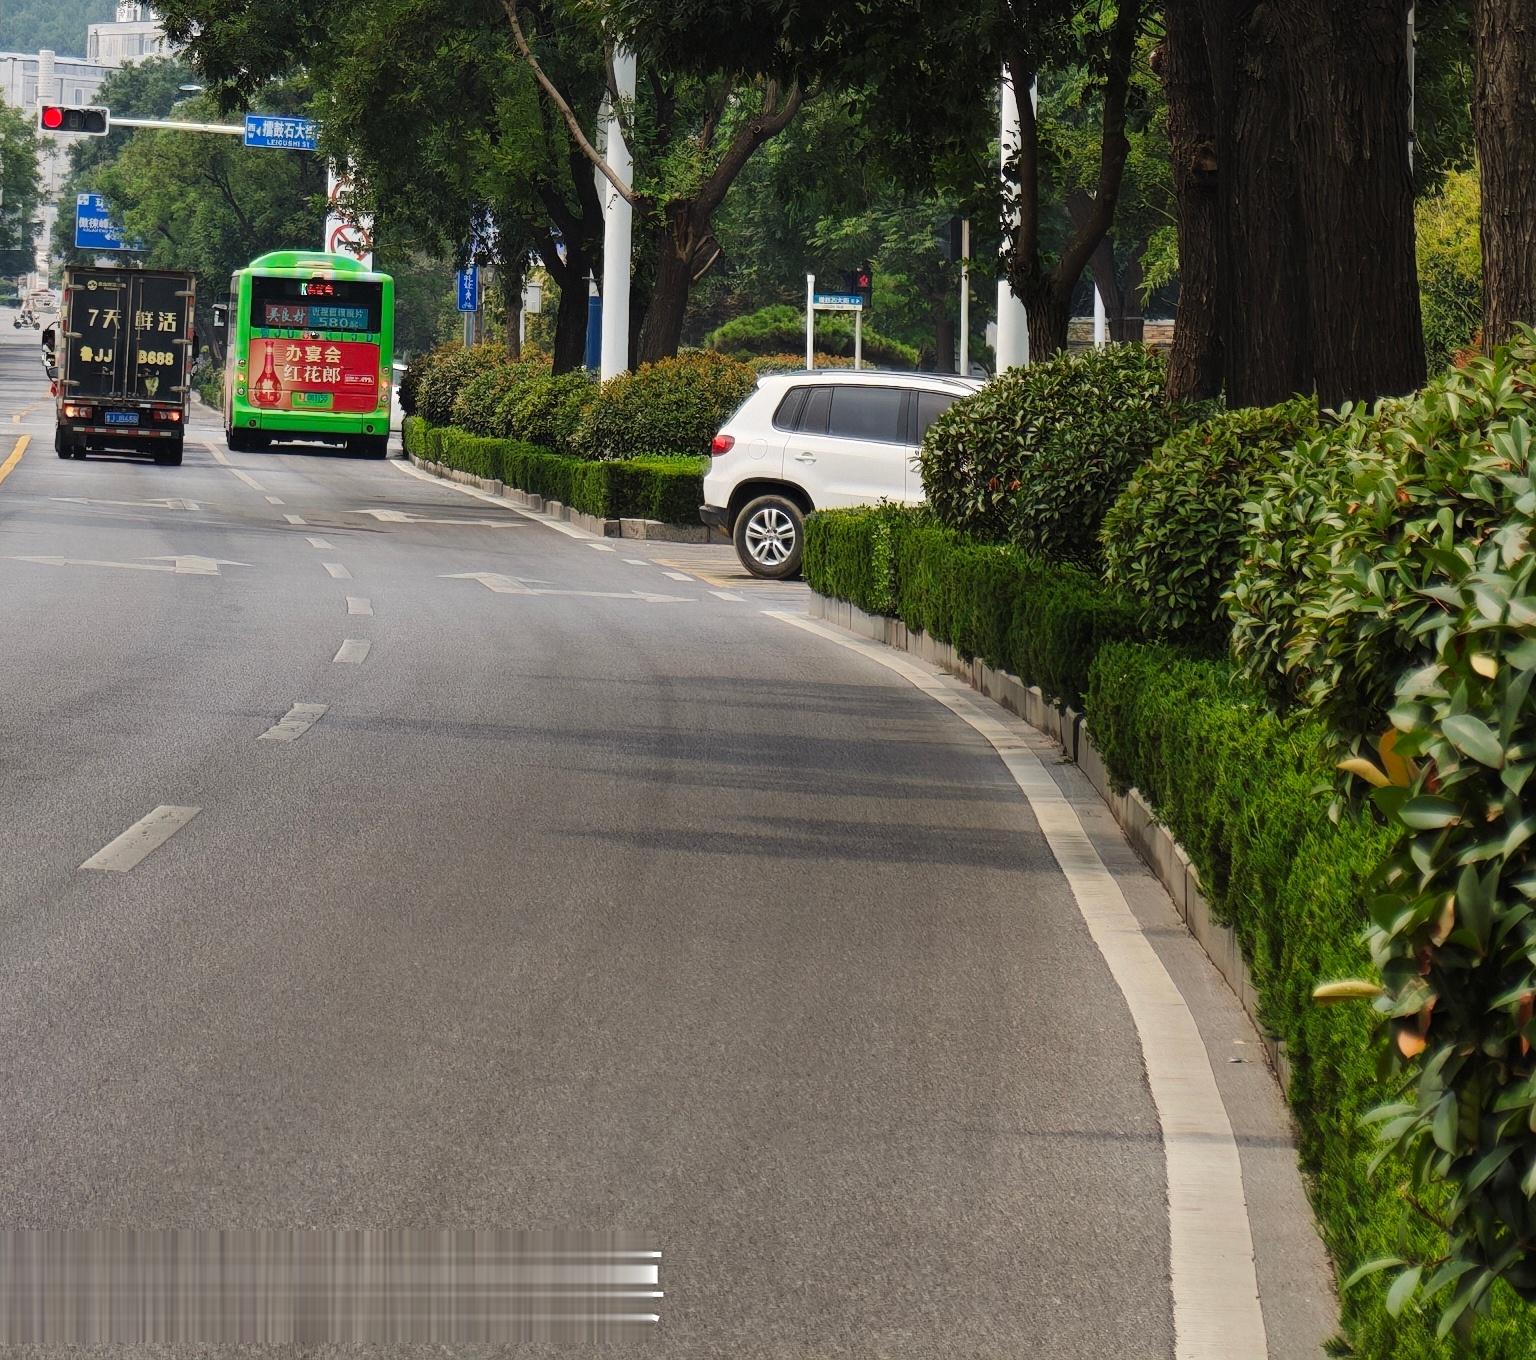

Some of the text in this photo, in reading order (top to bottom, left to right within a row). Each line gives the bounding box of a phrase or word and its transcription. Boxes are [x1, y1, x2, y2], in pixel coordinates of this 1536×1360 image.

[285, 344, 342, 364] 办宴会
[283, 363, 342, 384] 红花郎
